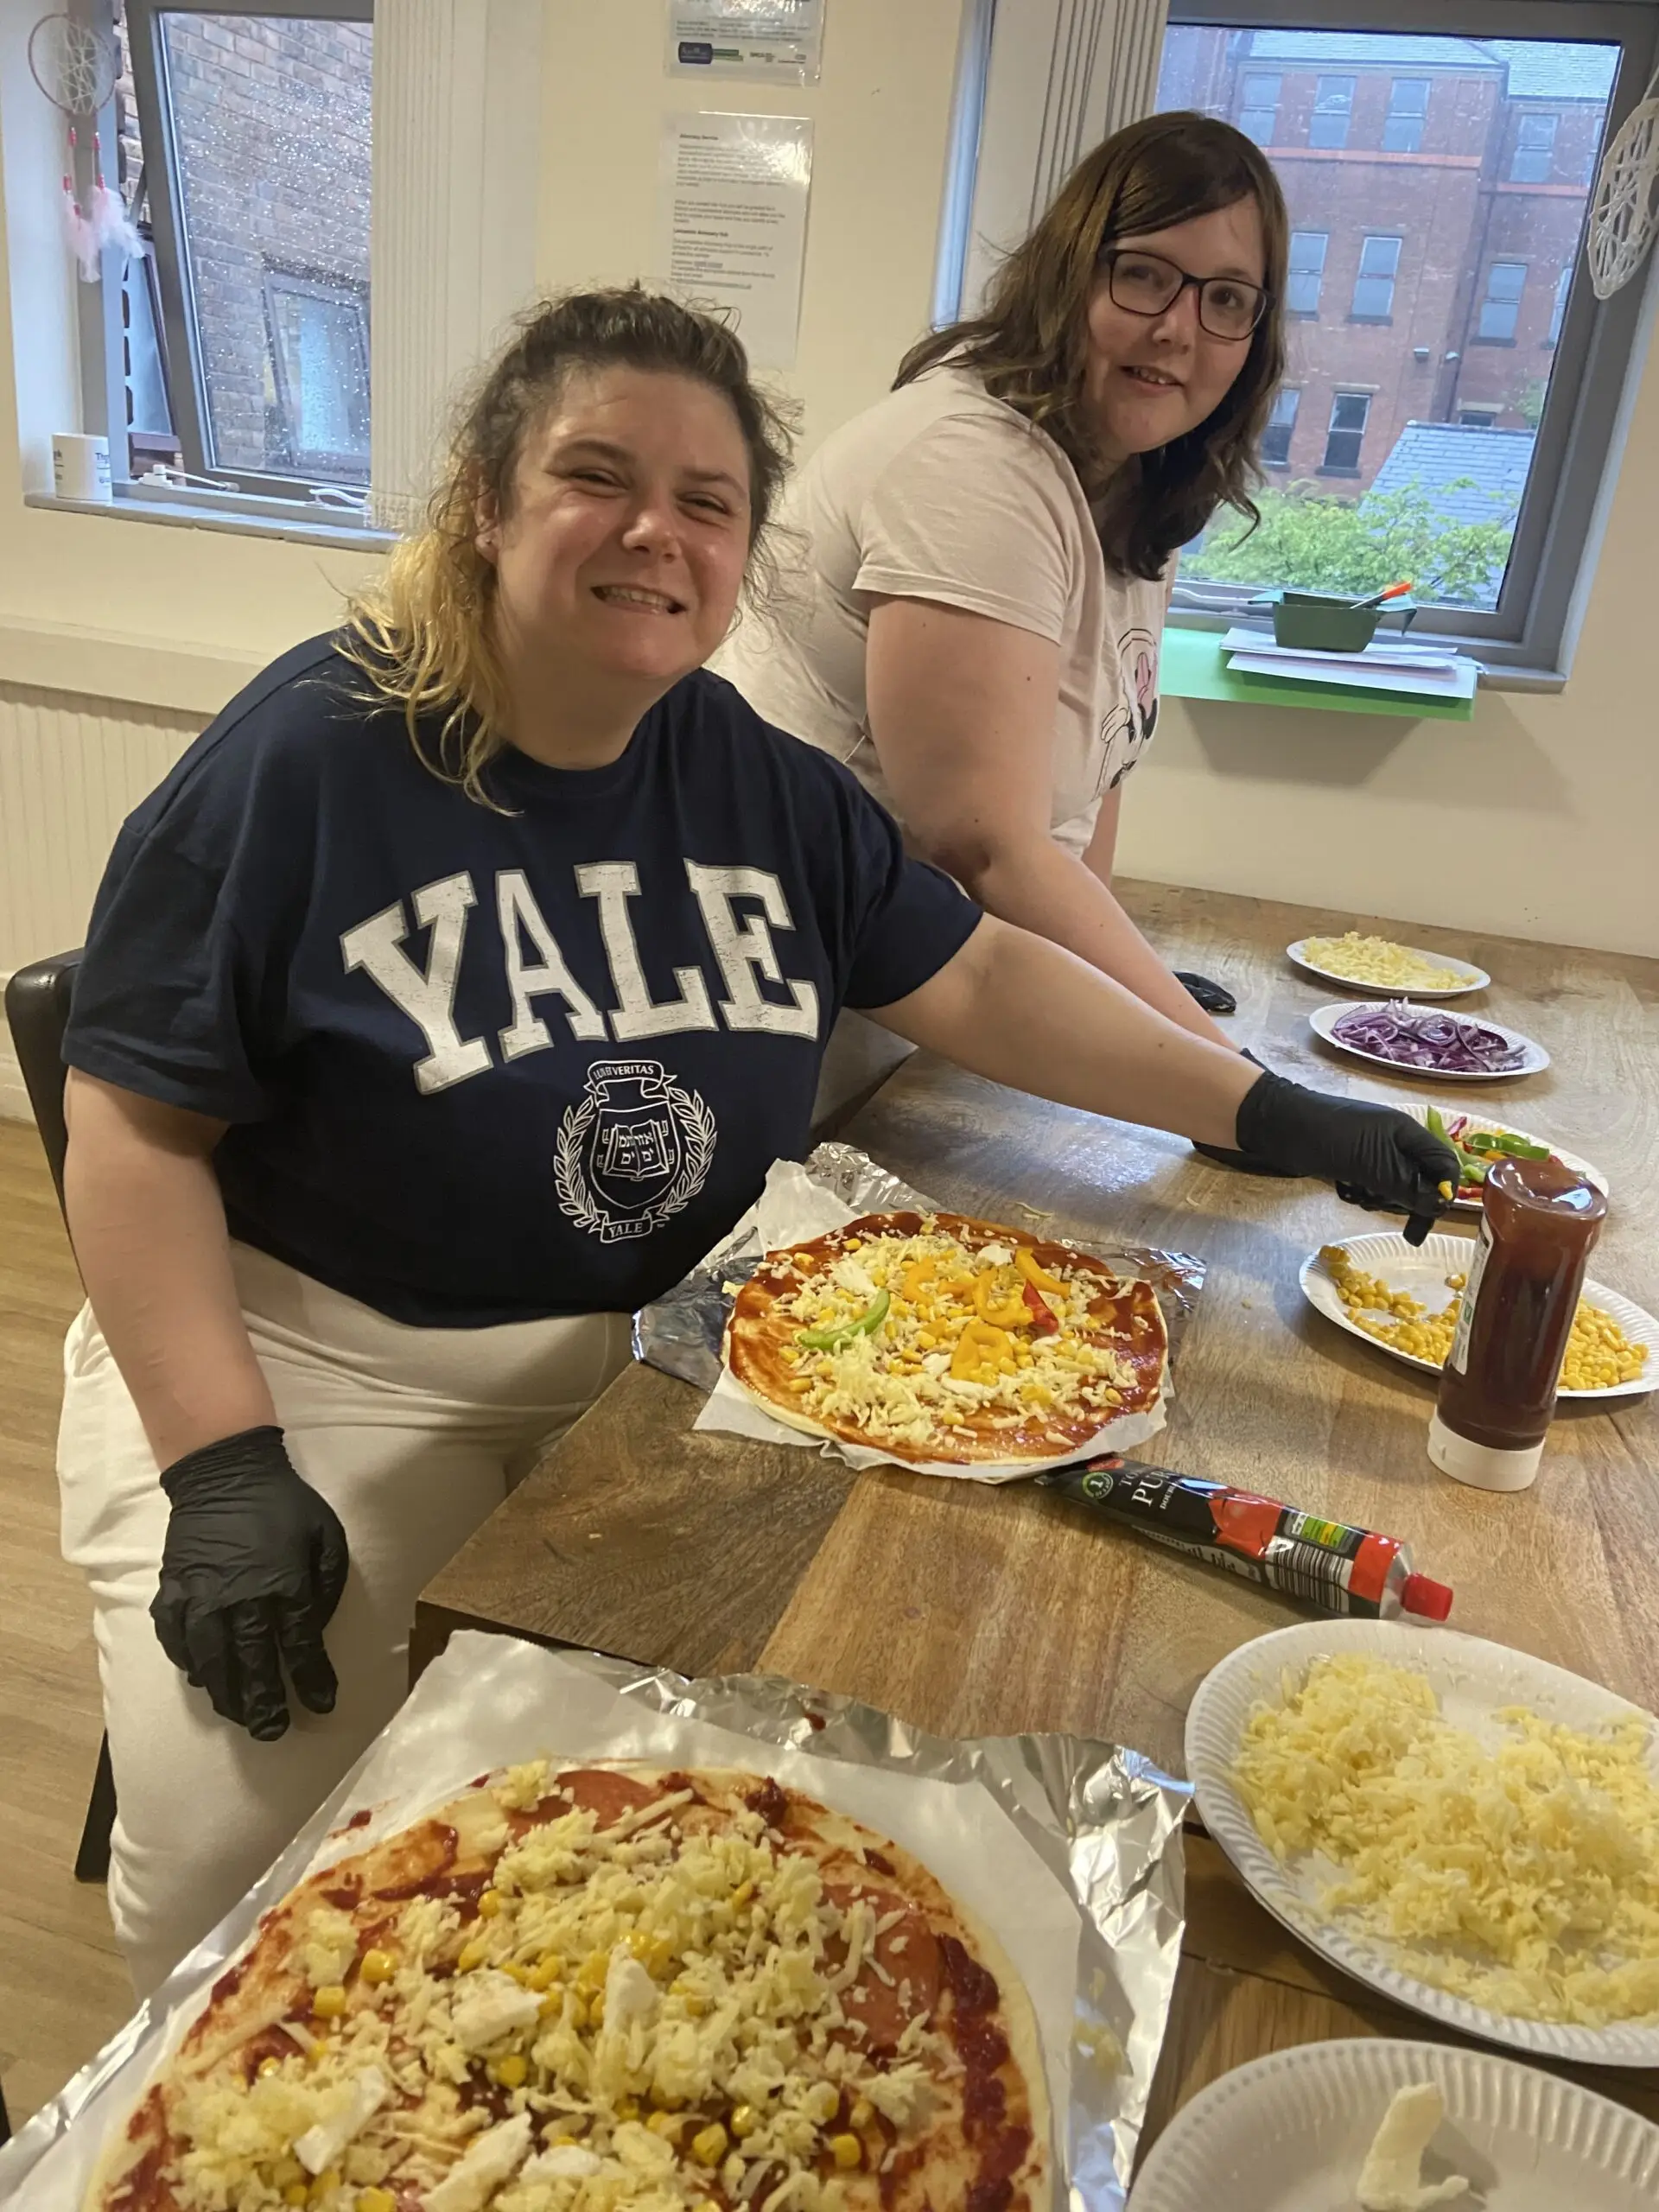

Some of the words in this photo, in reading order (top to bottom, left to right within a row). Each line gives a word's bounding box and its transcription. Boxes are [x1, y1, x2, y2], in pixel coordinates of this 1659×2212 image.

[339, 857, 818, 1095] YALE
[612, 1065, 654, 1076] VERITAS
[608, 1223, 643, 1238] YALE
